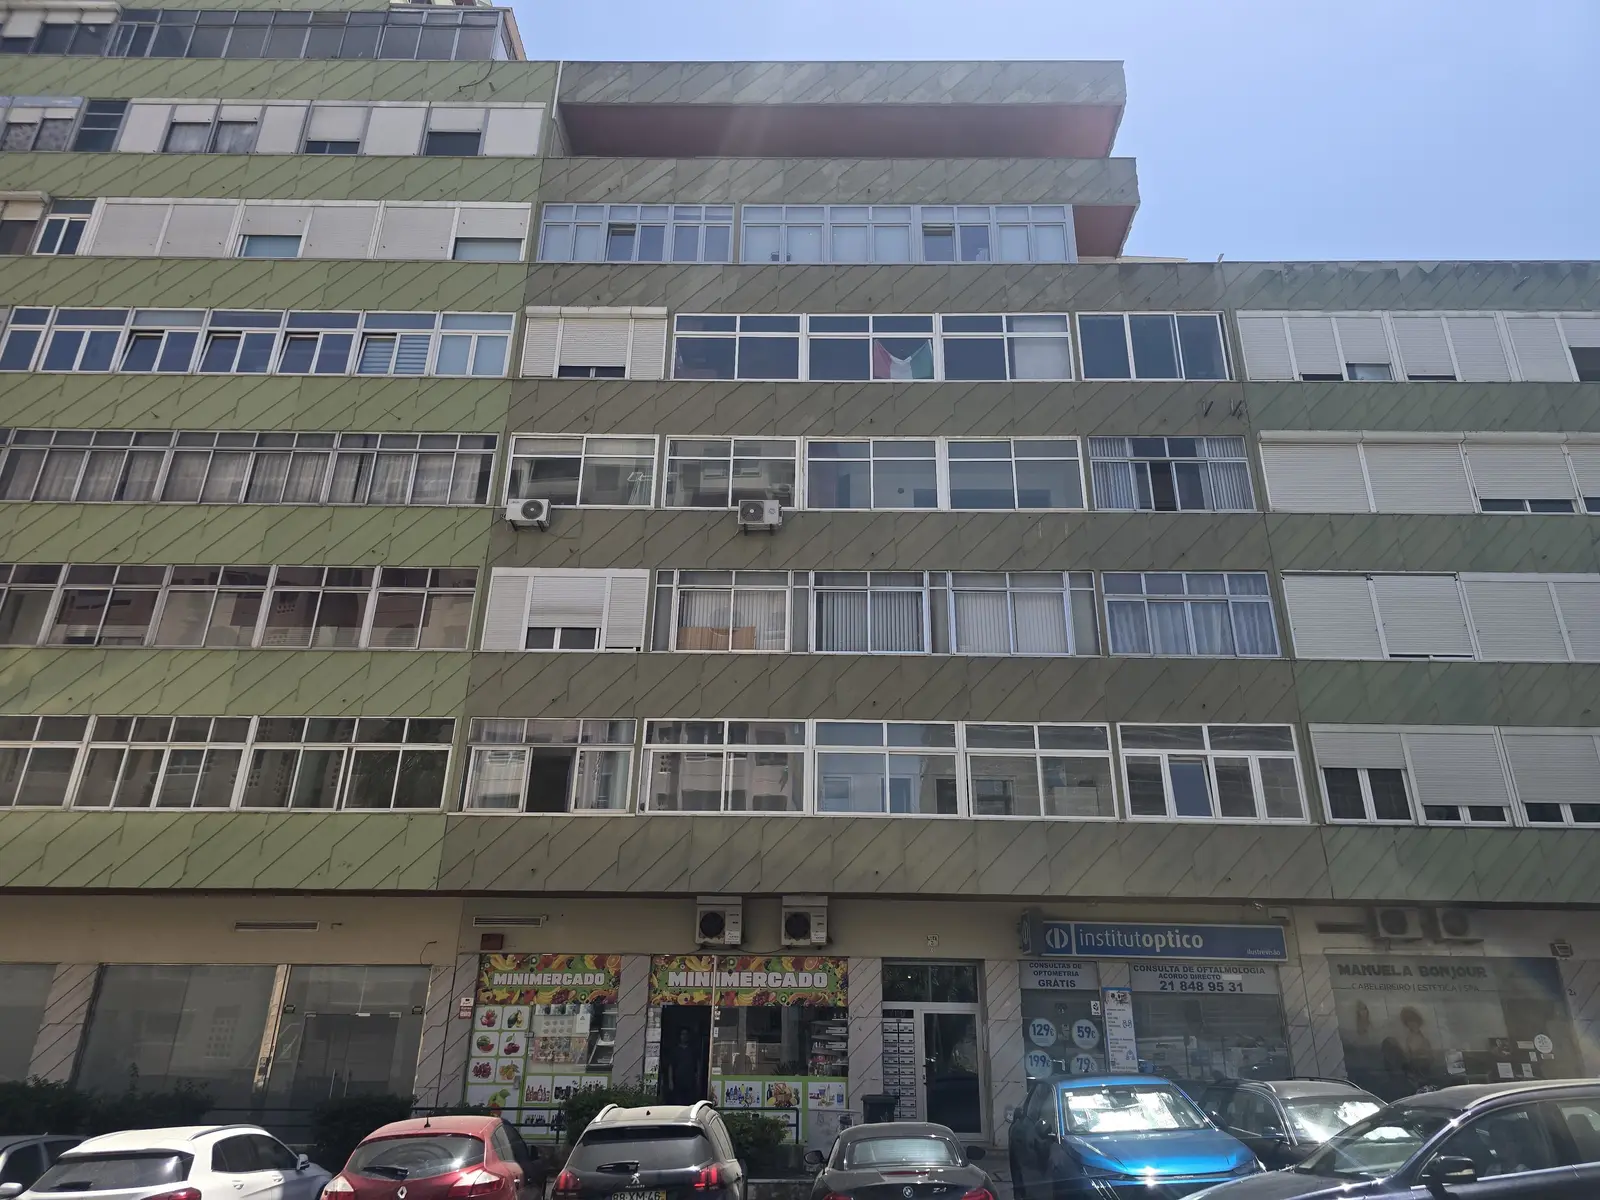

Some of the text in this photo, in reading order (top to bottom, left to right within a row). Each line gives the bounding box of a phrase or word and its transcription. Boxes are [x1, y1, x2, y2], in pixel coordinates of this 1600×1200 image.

[1079, 929, 1204, 952] institutoptico
[1133, 965, 1266, 975] CONSULTA DE OFTALMOLOGIA
[1336, 964, 1487, 979] MANUELA BONJOUR
[493, 973, 605, 986] MINIMERCADO
[667, 971, 828, 989] MINIMERCADO
[1038, 978, 1076, 988] GRÁTIS
[1159, 981, 1244, 992] 21 848 95 31
[1351, 982, 1411, 991] CABELEIREIRO
[1031, 1023, 1096, 1039] 129€ 59€
